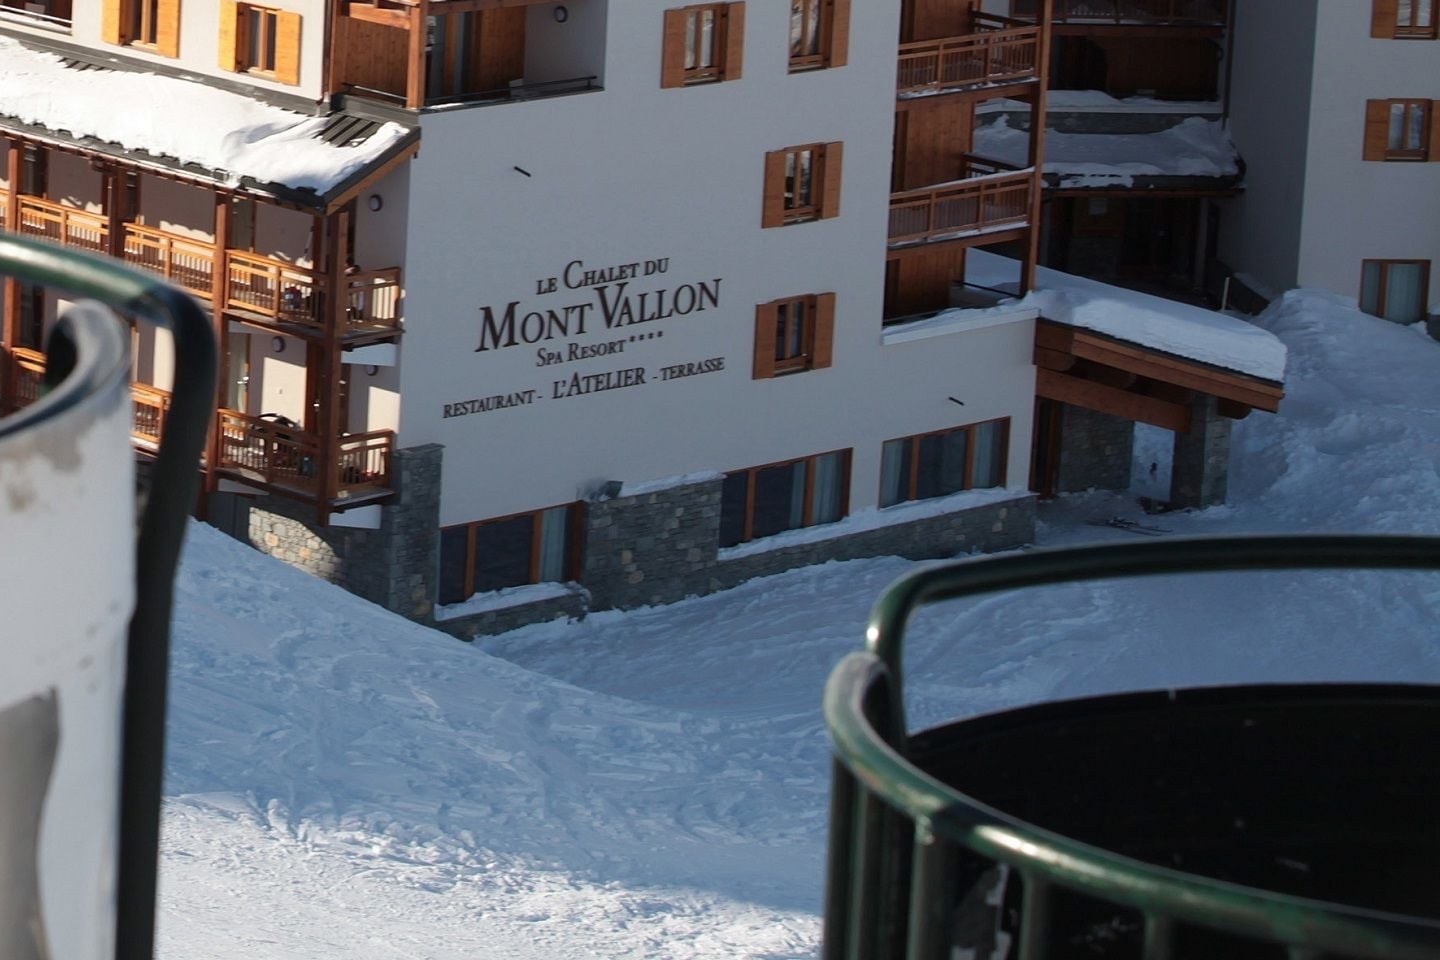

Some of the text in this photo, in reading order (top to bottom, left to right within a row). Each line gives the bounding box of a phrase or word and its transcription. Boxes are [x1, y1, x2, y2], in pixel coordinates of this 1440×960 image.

[536, 257, 670, 295] LE CHALET DU
[536, 339, 627, 368] SPA RESORT
[442, 389, 536, 419] RESTAURANT
[552, 366, 647, 400] L'ATELIER
[659, 356, 726, 382] TERRASSE
